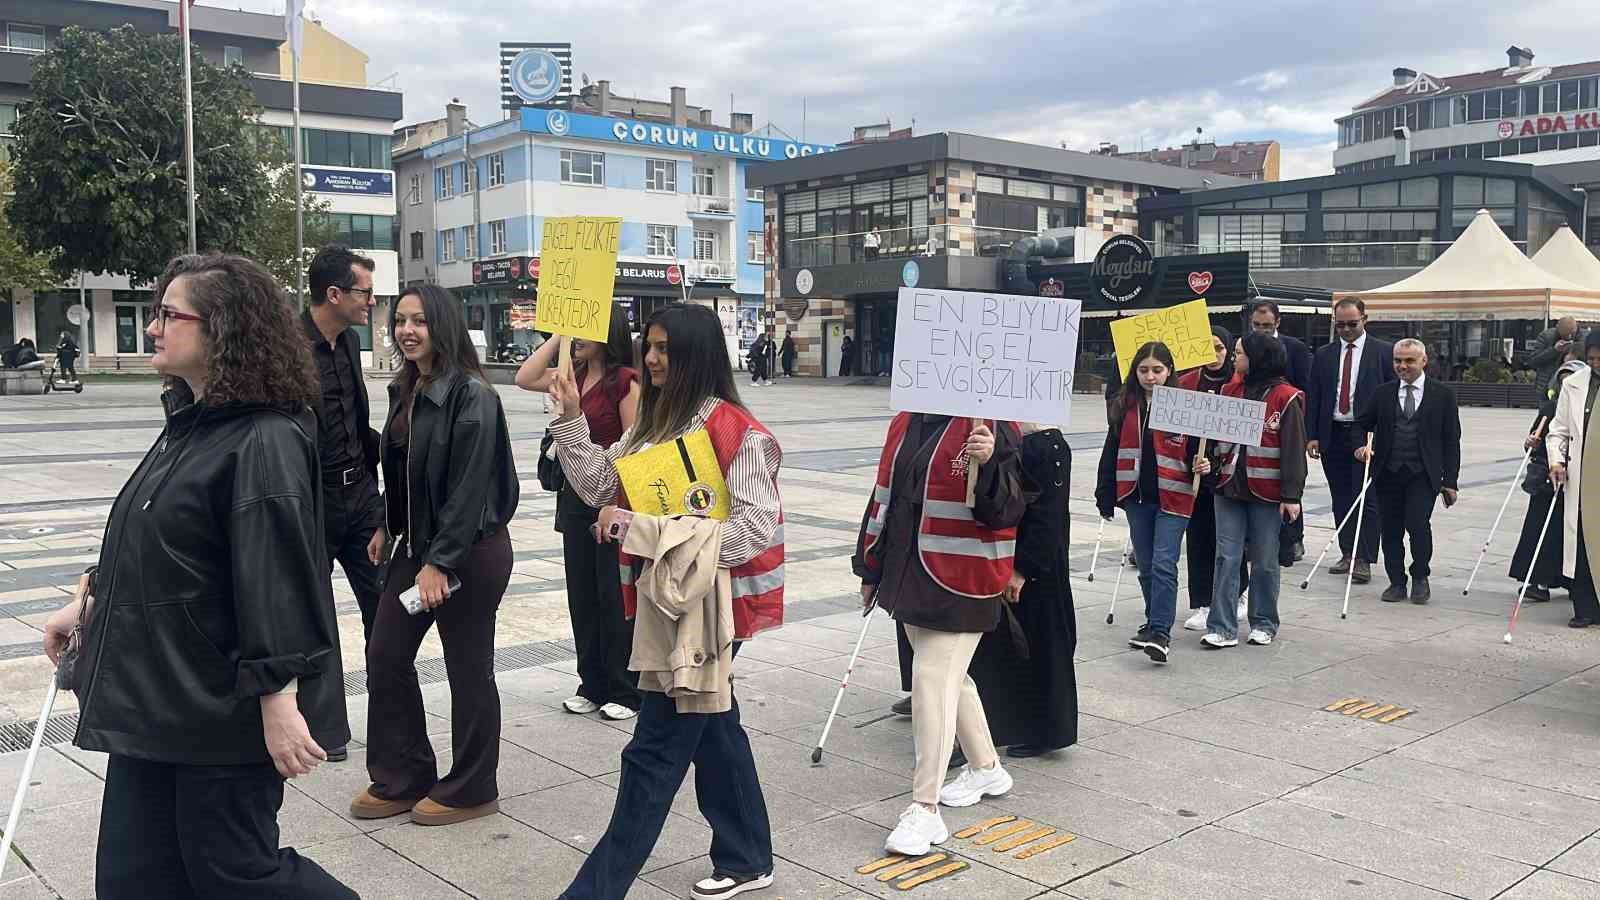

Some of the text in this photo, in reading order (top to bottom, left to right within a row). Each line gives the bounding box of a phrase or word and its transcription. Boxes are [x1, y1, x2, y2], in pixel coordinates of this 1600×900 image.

[613, 122, 697, 148] ÇORUM
[1520, 115, 1567, 136] ADA
[623, 268, 665, 278] BELARUS
[913, 293, 1080, 332] EN BÜYÜK
[931, 328, 1048, 363] ENGEL
[1156, 387, 1178, 406] EN
